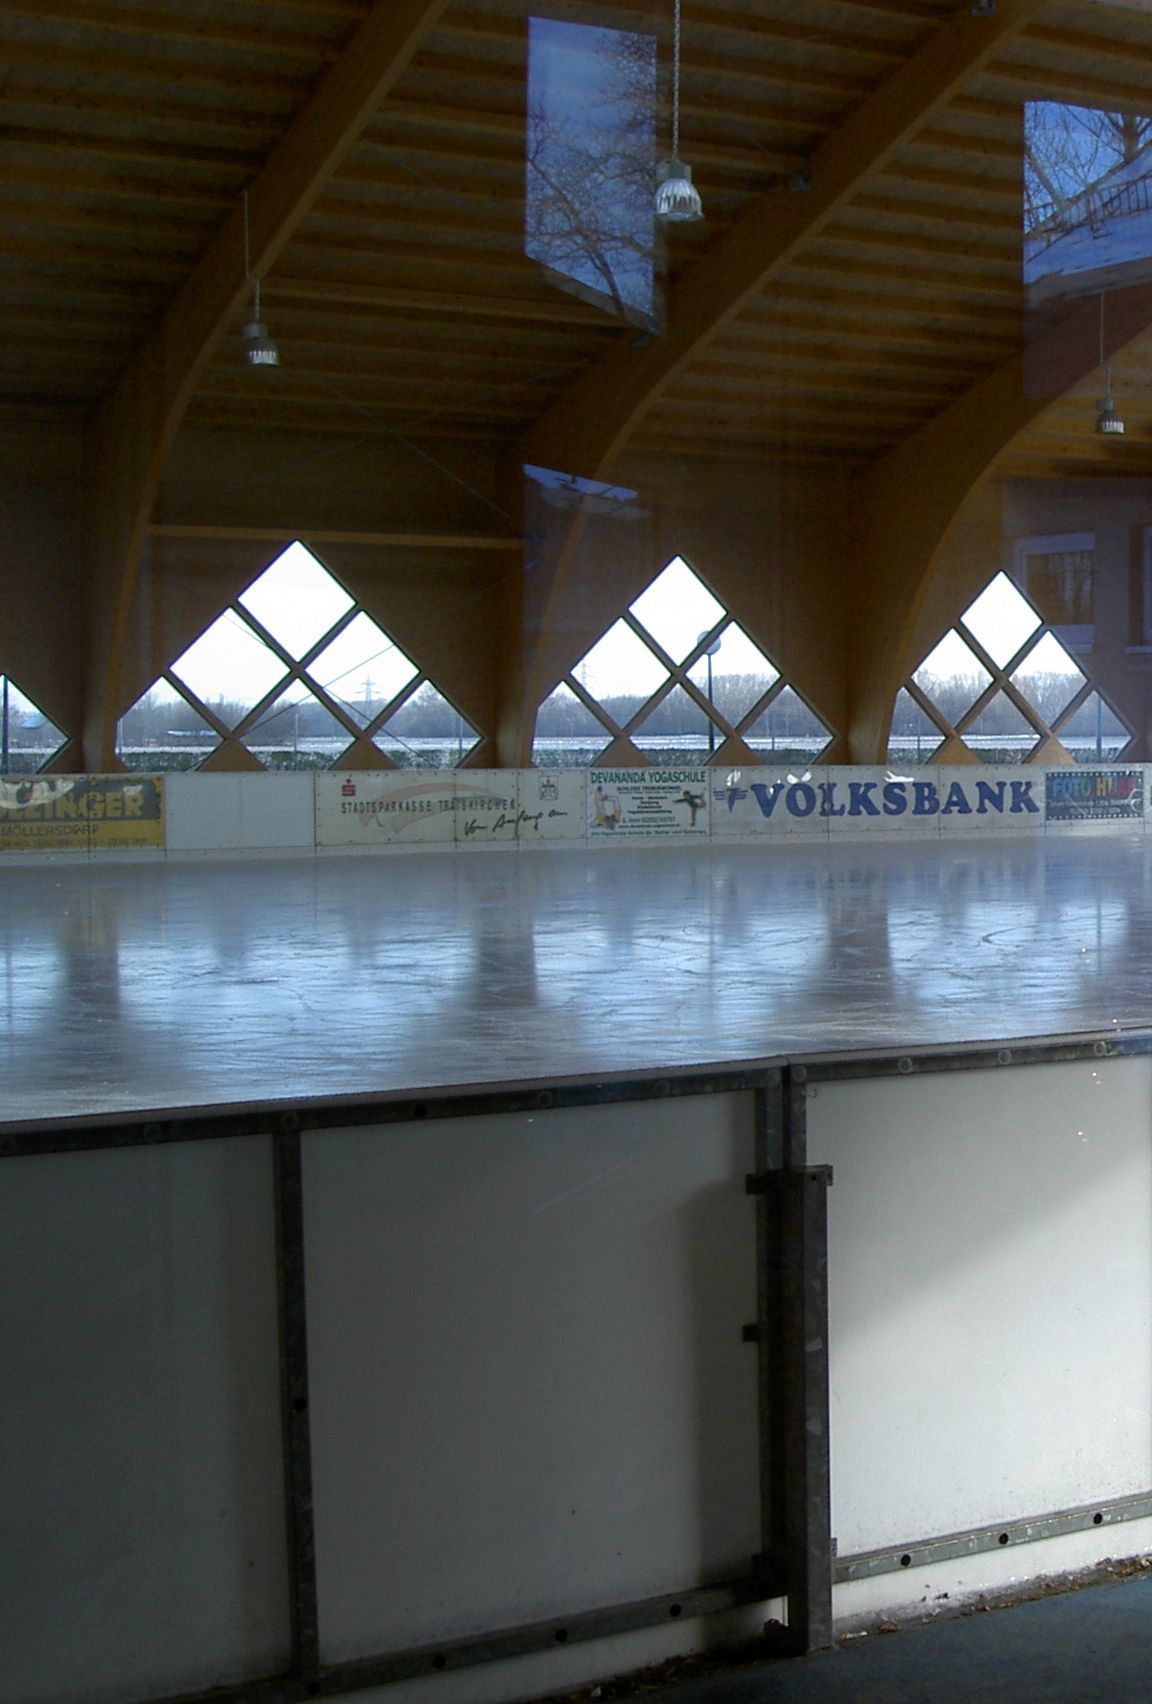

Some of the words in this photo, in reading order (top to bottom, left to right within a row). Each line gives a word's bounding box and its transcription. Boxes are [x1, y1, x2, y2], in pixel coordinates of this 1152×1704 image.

[591, 771, 646, 784] DEVANANDA
[649, 771, 706, 783] YOGASCHULE
[1052, 777, 1091, 797] FOTO
[341, 799, 432, 815] STADTSPARKASSE
[439, 797, 516, 812] TRAISKIRCHEN
[750, 781, 1040, 818] VOLKSBANK
